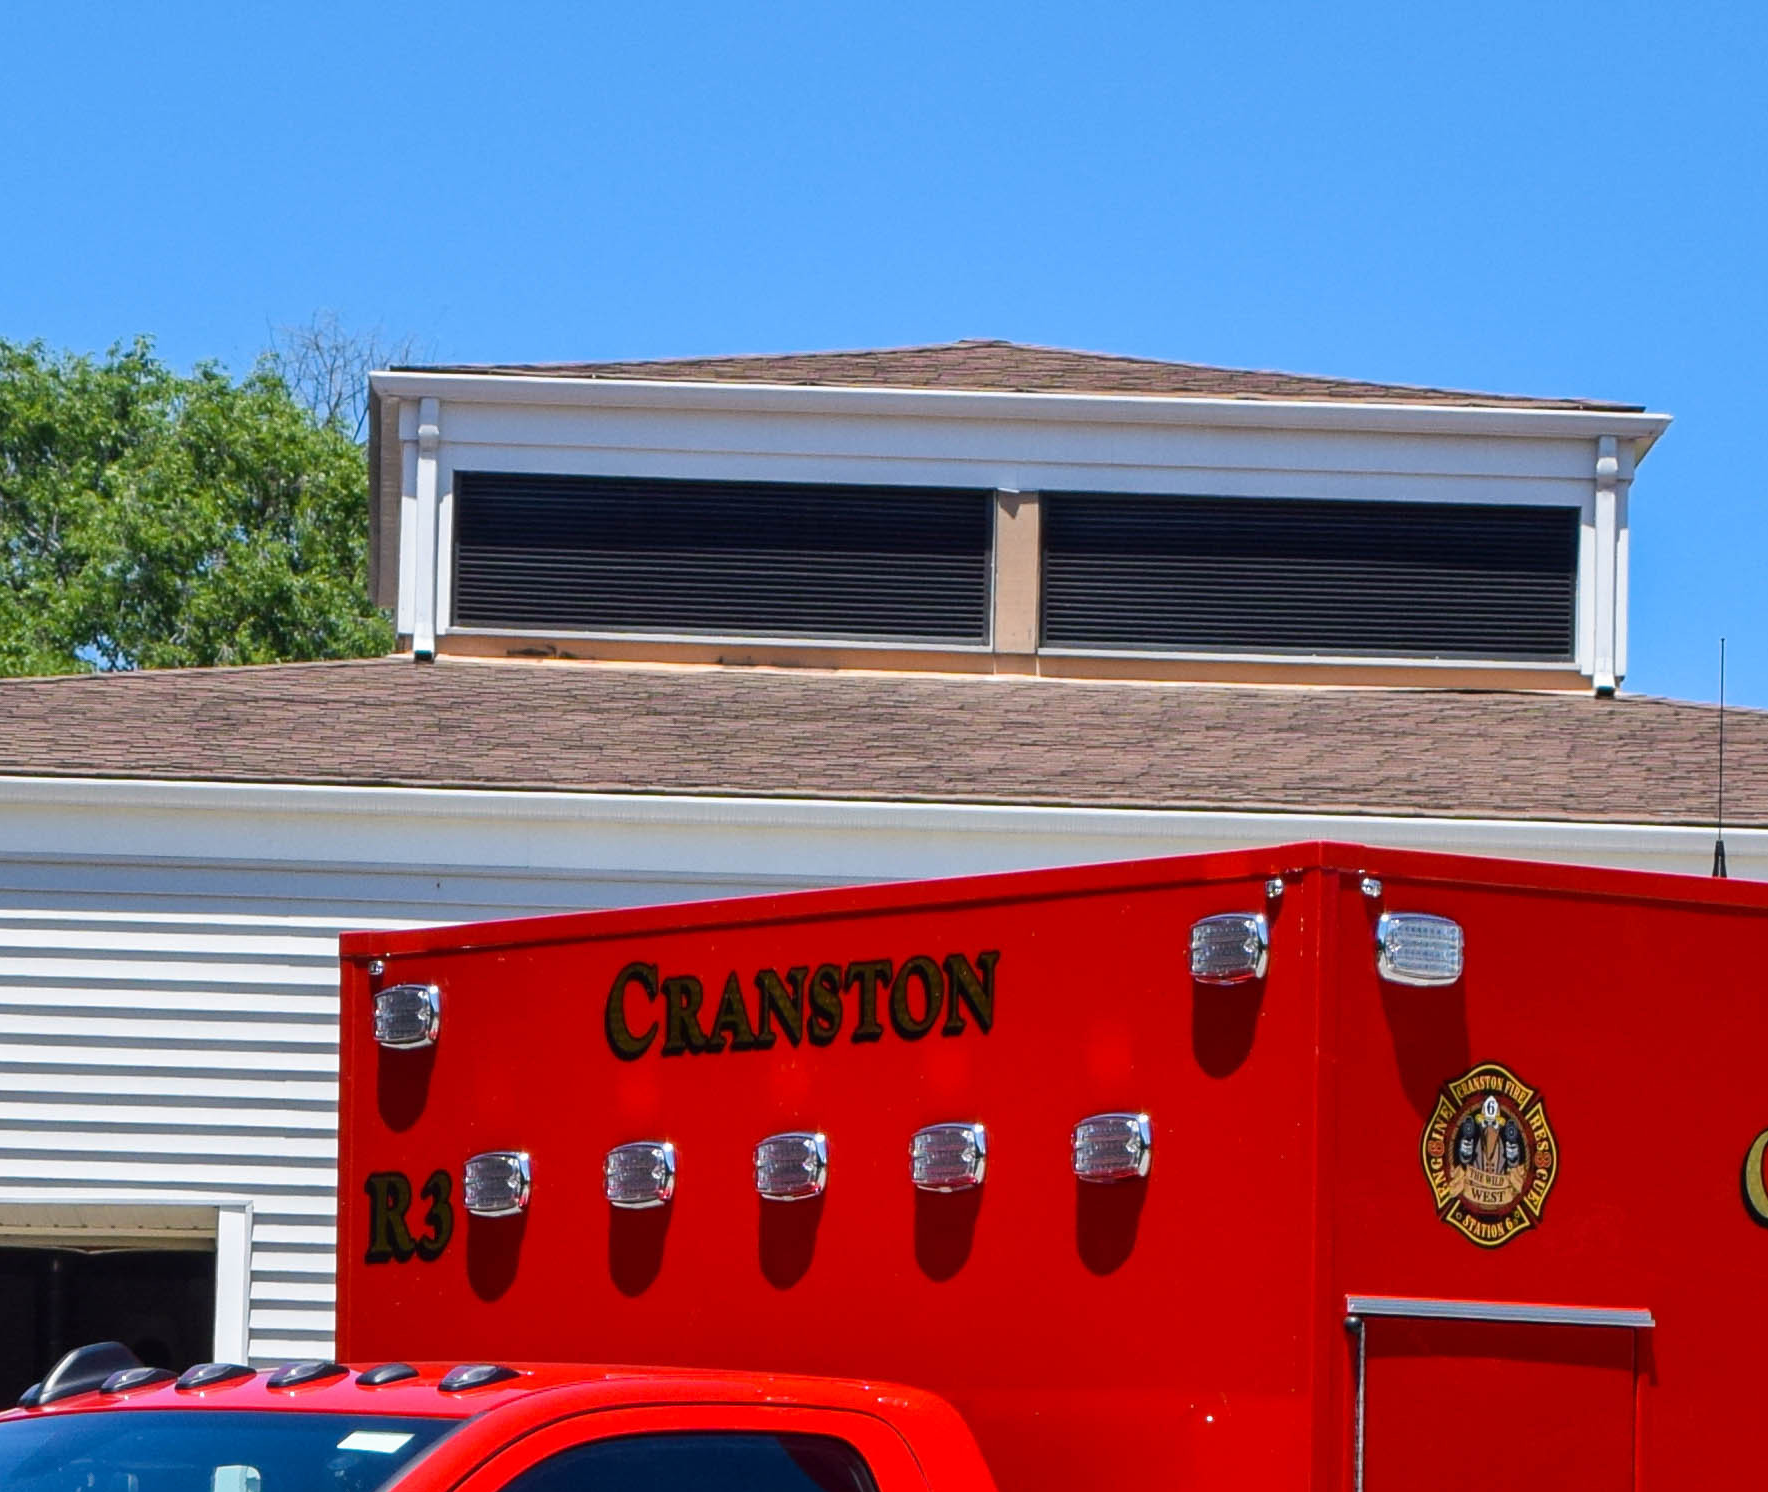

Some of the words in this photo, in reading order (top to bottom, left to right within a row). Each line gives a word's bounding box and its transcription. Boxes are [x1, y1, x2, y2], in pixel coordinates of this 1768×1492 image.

[605, 949, 1001, 1060] CRANSTON
[1456, 1075, 1504, 1098] CRANSTON
[1504, 1080, 1528, 1105] FIRE
[1486, 1100, 1496, 1116] 6
[1485, 1174, 1506, 1187] WILD
[1471, 1188, 1507, 1203] WEST
[364, 1169, 454, 1265] R3
[1462, 1214, 1506, 1239] STATION
[1505, 1217, 1514, 1230] 6
